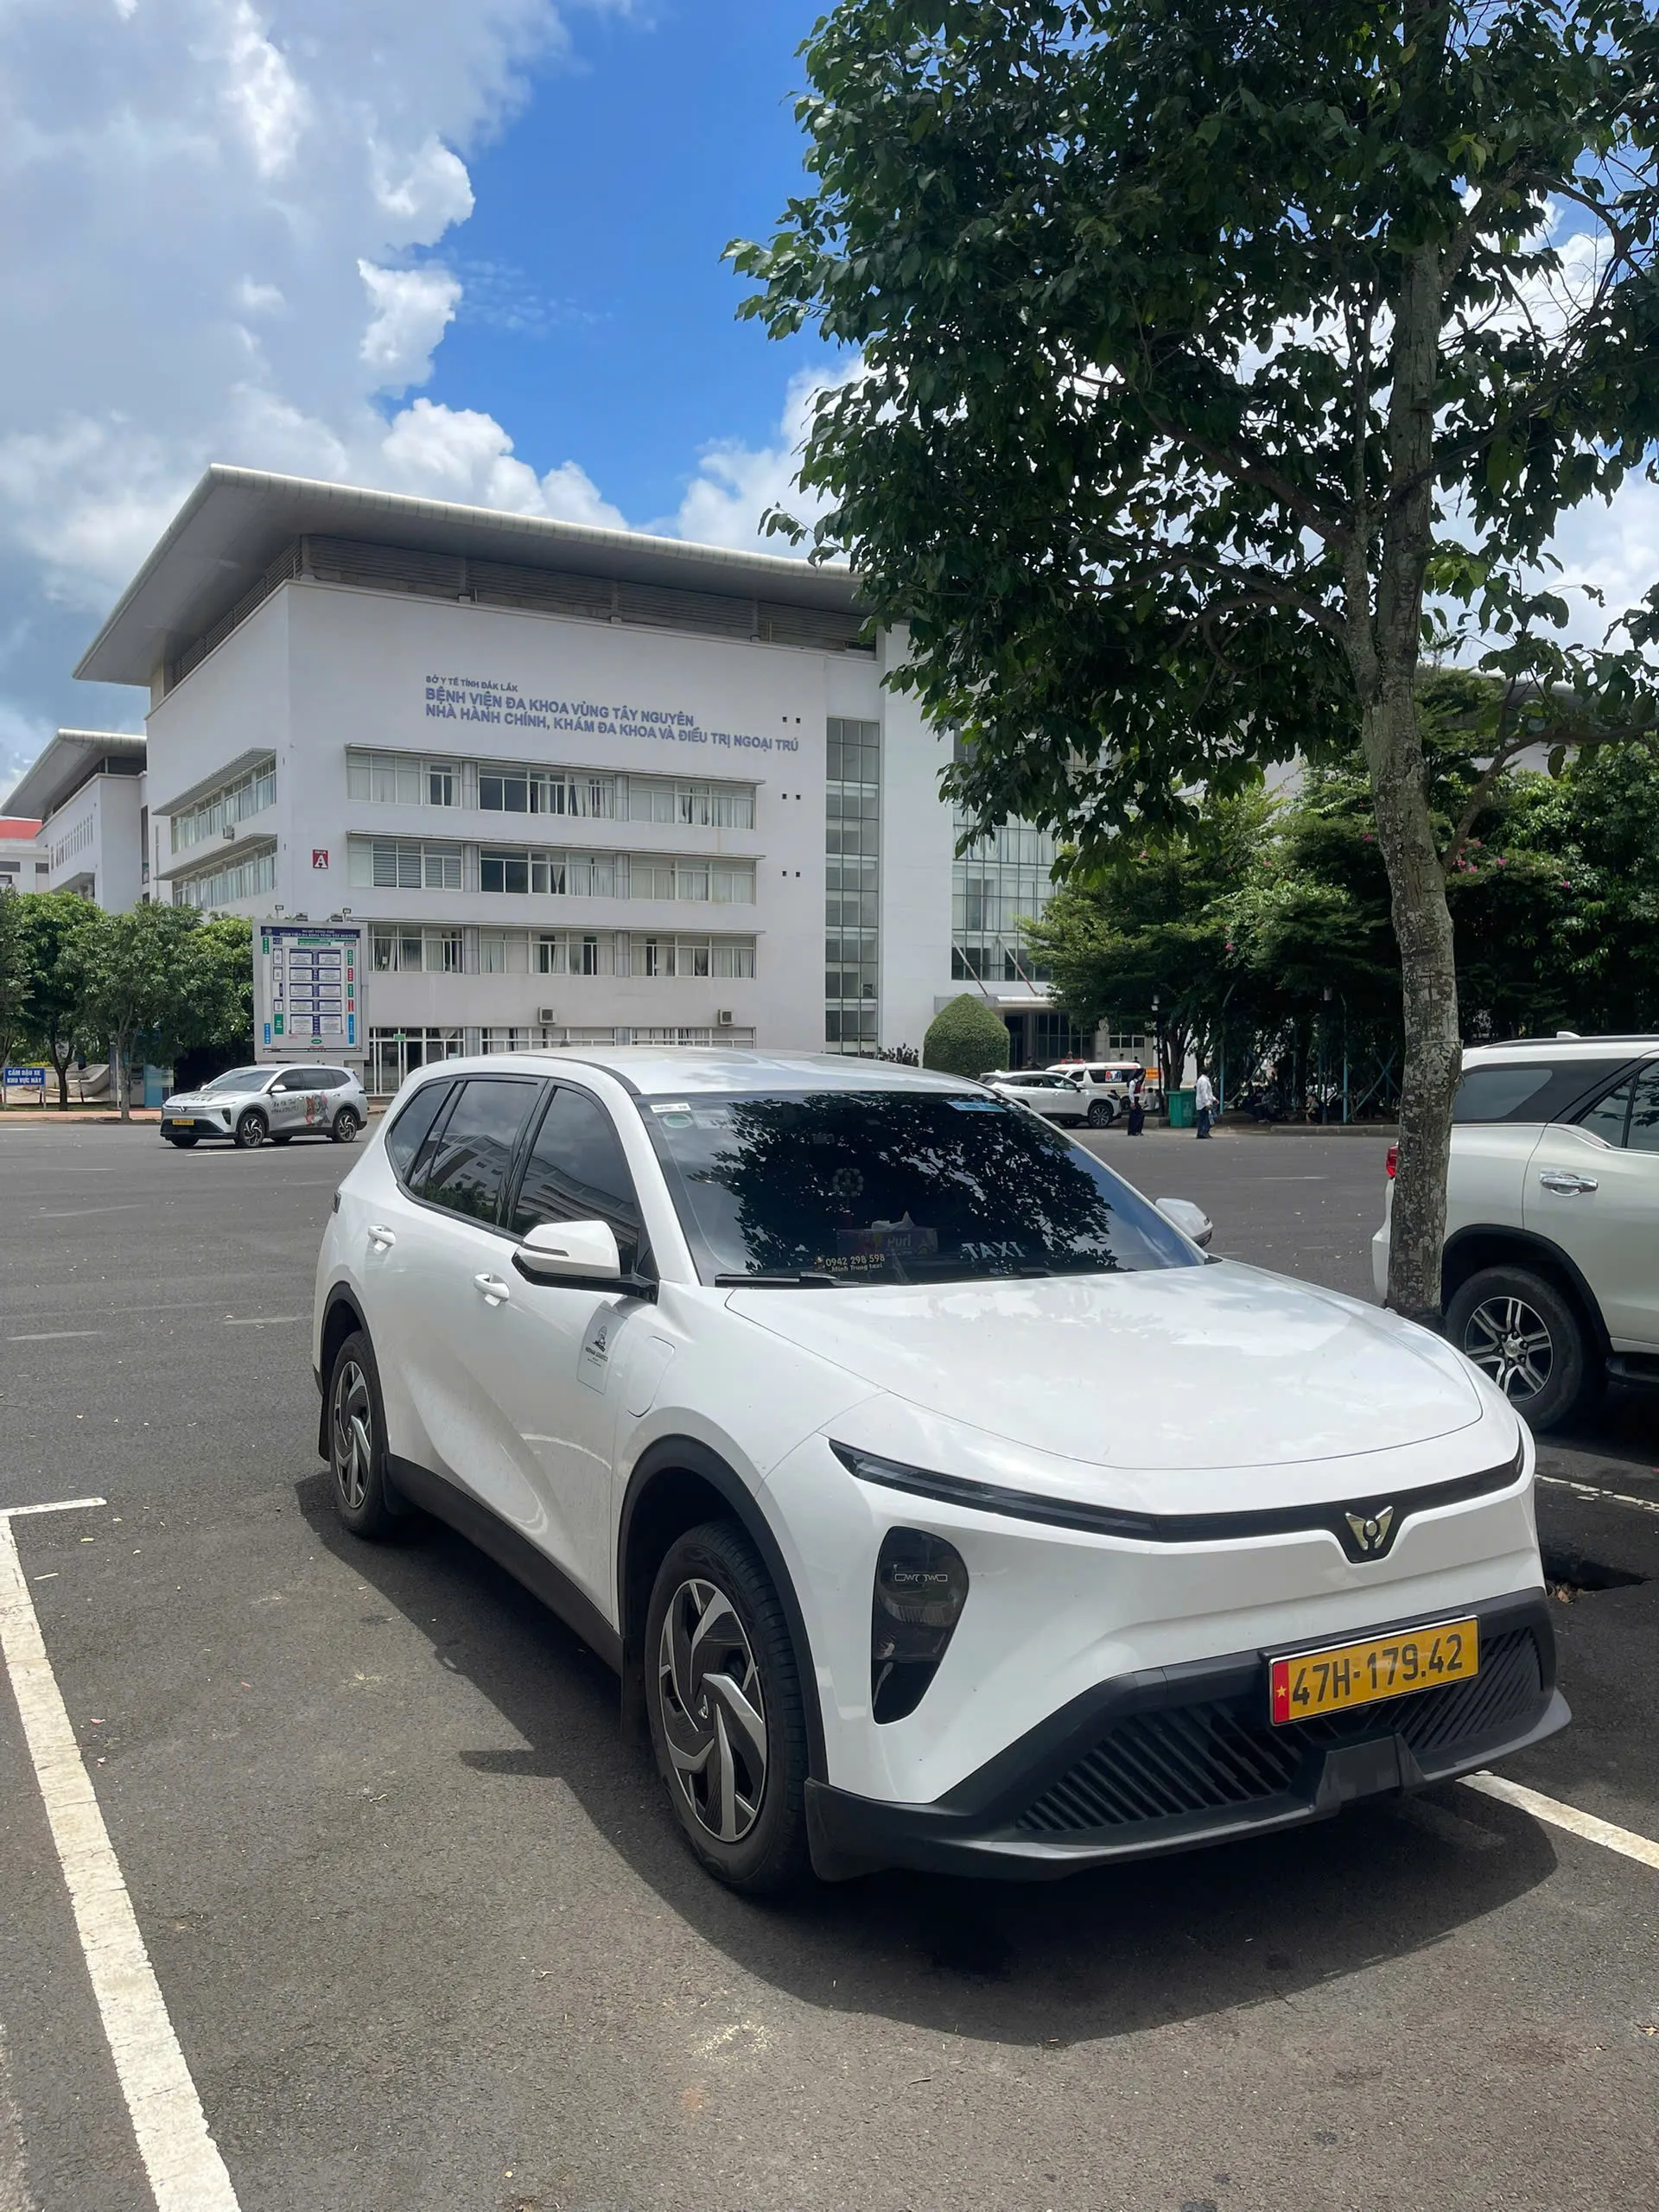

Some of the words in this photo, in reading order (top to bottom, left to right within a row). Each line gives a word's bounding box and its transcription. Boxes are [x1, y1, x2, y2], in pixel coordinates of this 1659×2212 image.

[426, 674, 439, 683] SỞ
[425, 686, 466, 705] BỆNH
[468, 691, 502, 710] VIỆN
[505, 696, 526, 710] ĐA
[529, 698, 569, 715] KHOA
[570, 701, 609, 719] VÙNG
[612, 705, 638, 721] TÂY
[640, 710, 694, 727] NGUYÊN
[425, 703, 456, 719] NHÀ
[461, 706, 500, 724] HÀNH
[504, 711, 550, 730] CHÍNH,
[553, 716, 594, 733] KHÁM
[597, 721, 617, 734] ĐA
[620, 723, 657, 739] KHOA
[658, 724, 675, 741] VÀ
[710, 733, 731, 748] TRỊ
[734, 734, 772, 752] NGOẠI
[775, 737, 798, 752] TRÚ
[314, 854, 327, 868] A
[960, 1241, 1027, 1259] TAXI
[825, 1256, 848, 1267] 0942
[849, 1255, 868, 1265] 298
[869, 1253, 886, 1263] 598
[1292, 1634, 1463, 1706] 47H-179.42
